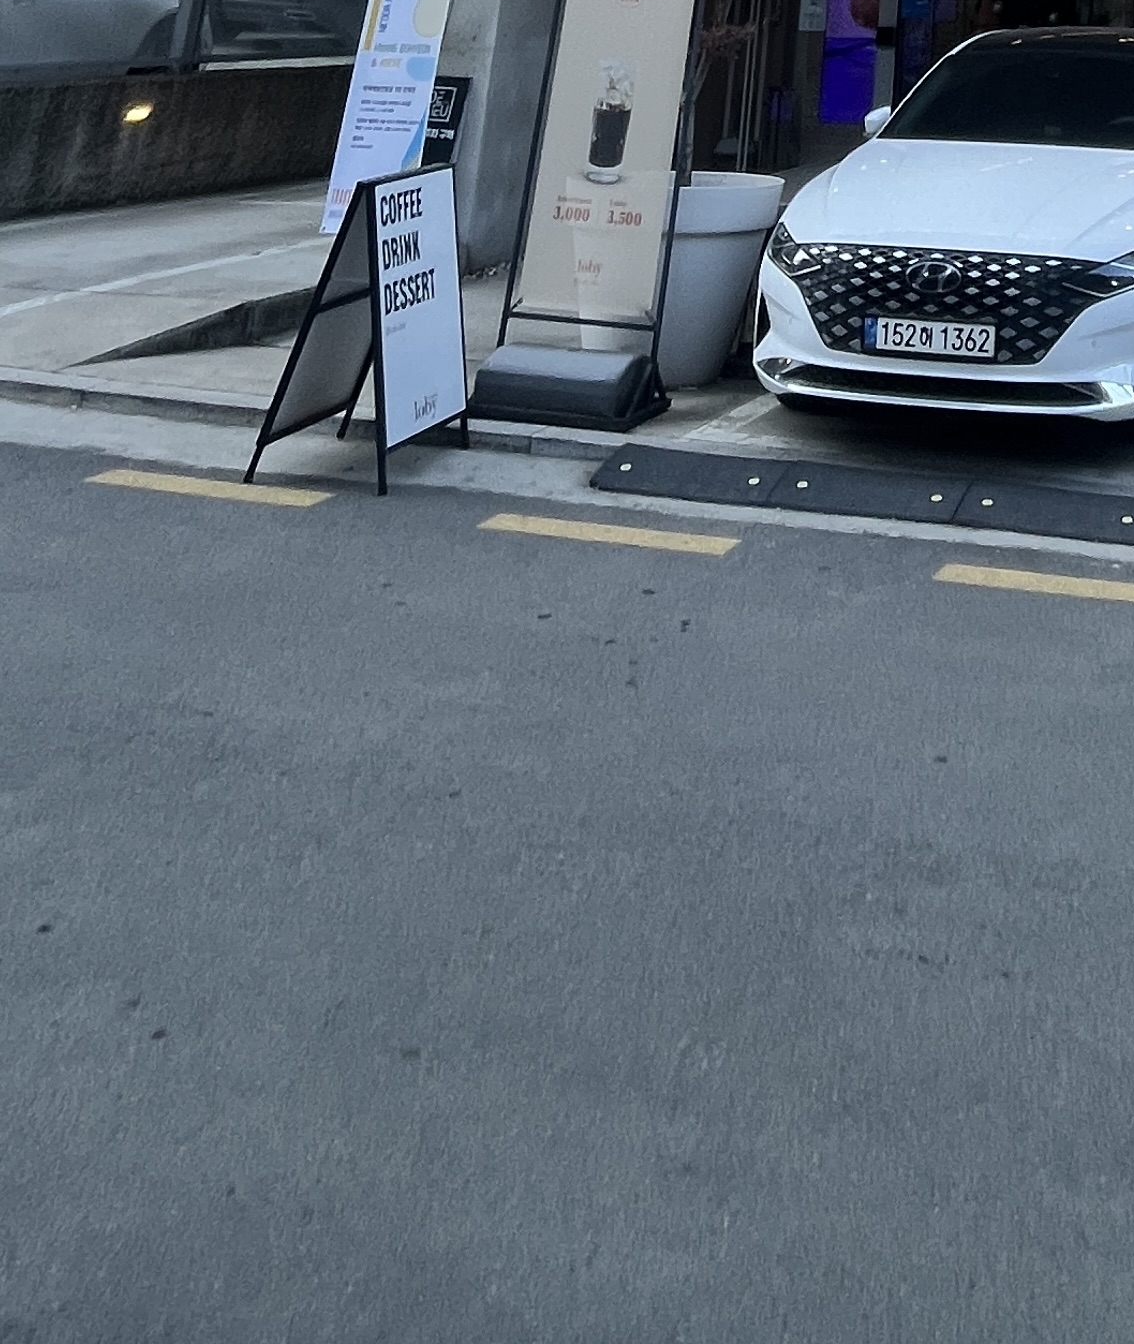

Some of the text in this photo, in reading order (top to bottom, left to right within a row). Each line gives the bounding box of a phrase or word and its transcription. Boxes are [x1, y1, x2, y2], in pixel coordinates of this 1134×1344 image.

[380, 186, 423, 228] COFFEE
[382, 230, 421, 272] DRINK
[384, 267, 436, 316] DESSERT
[939, 325, 991, 354] 1362
